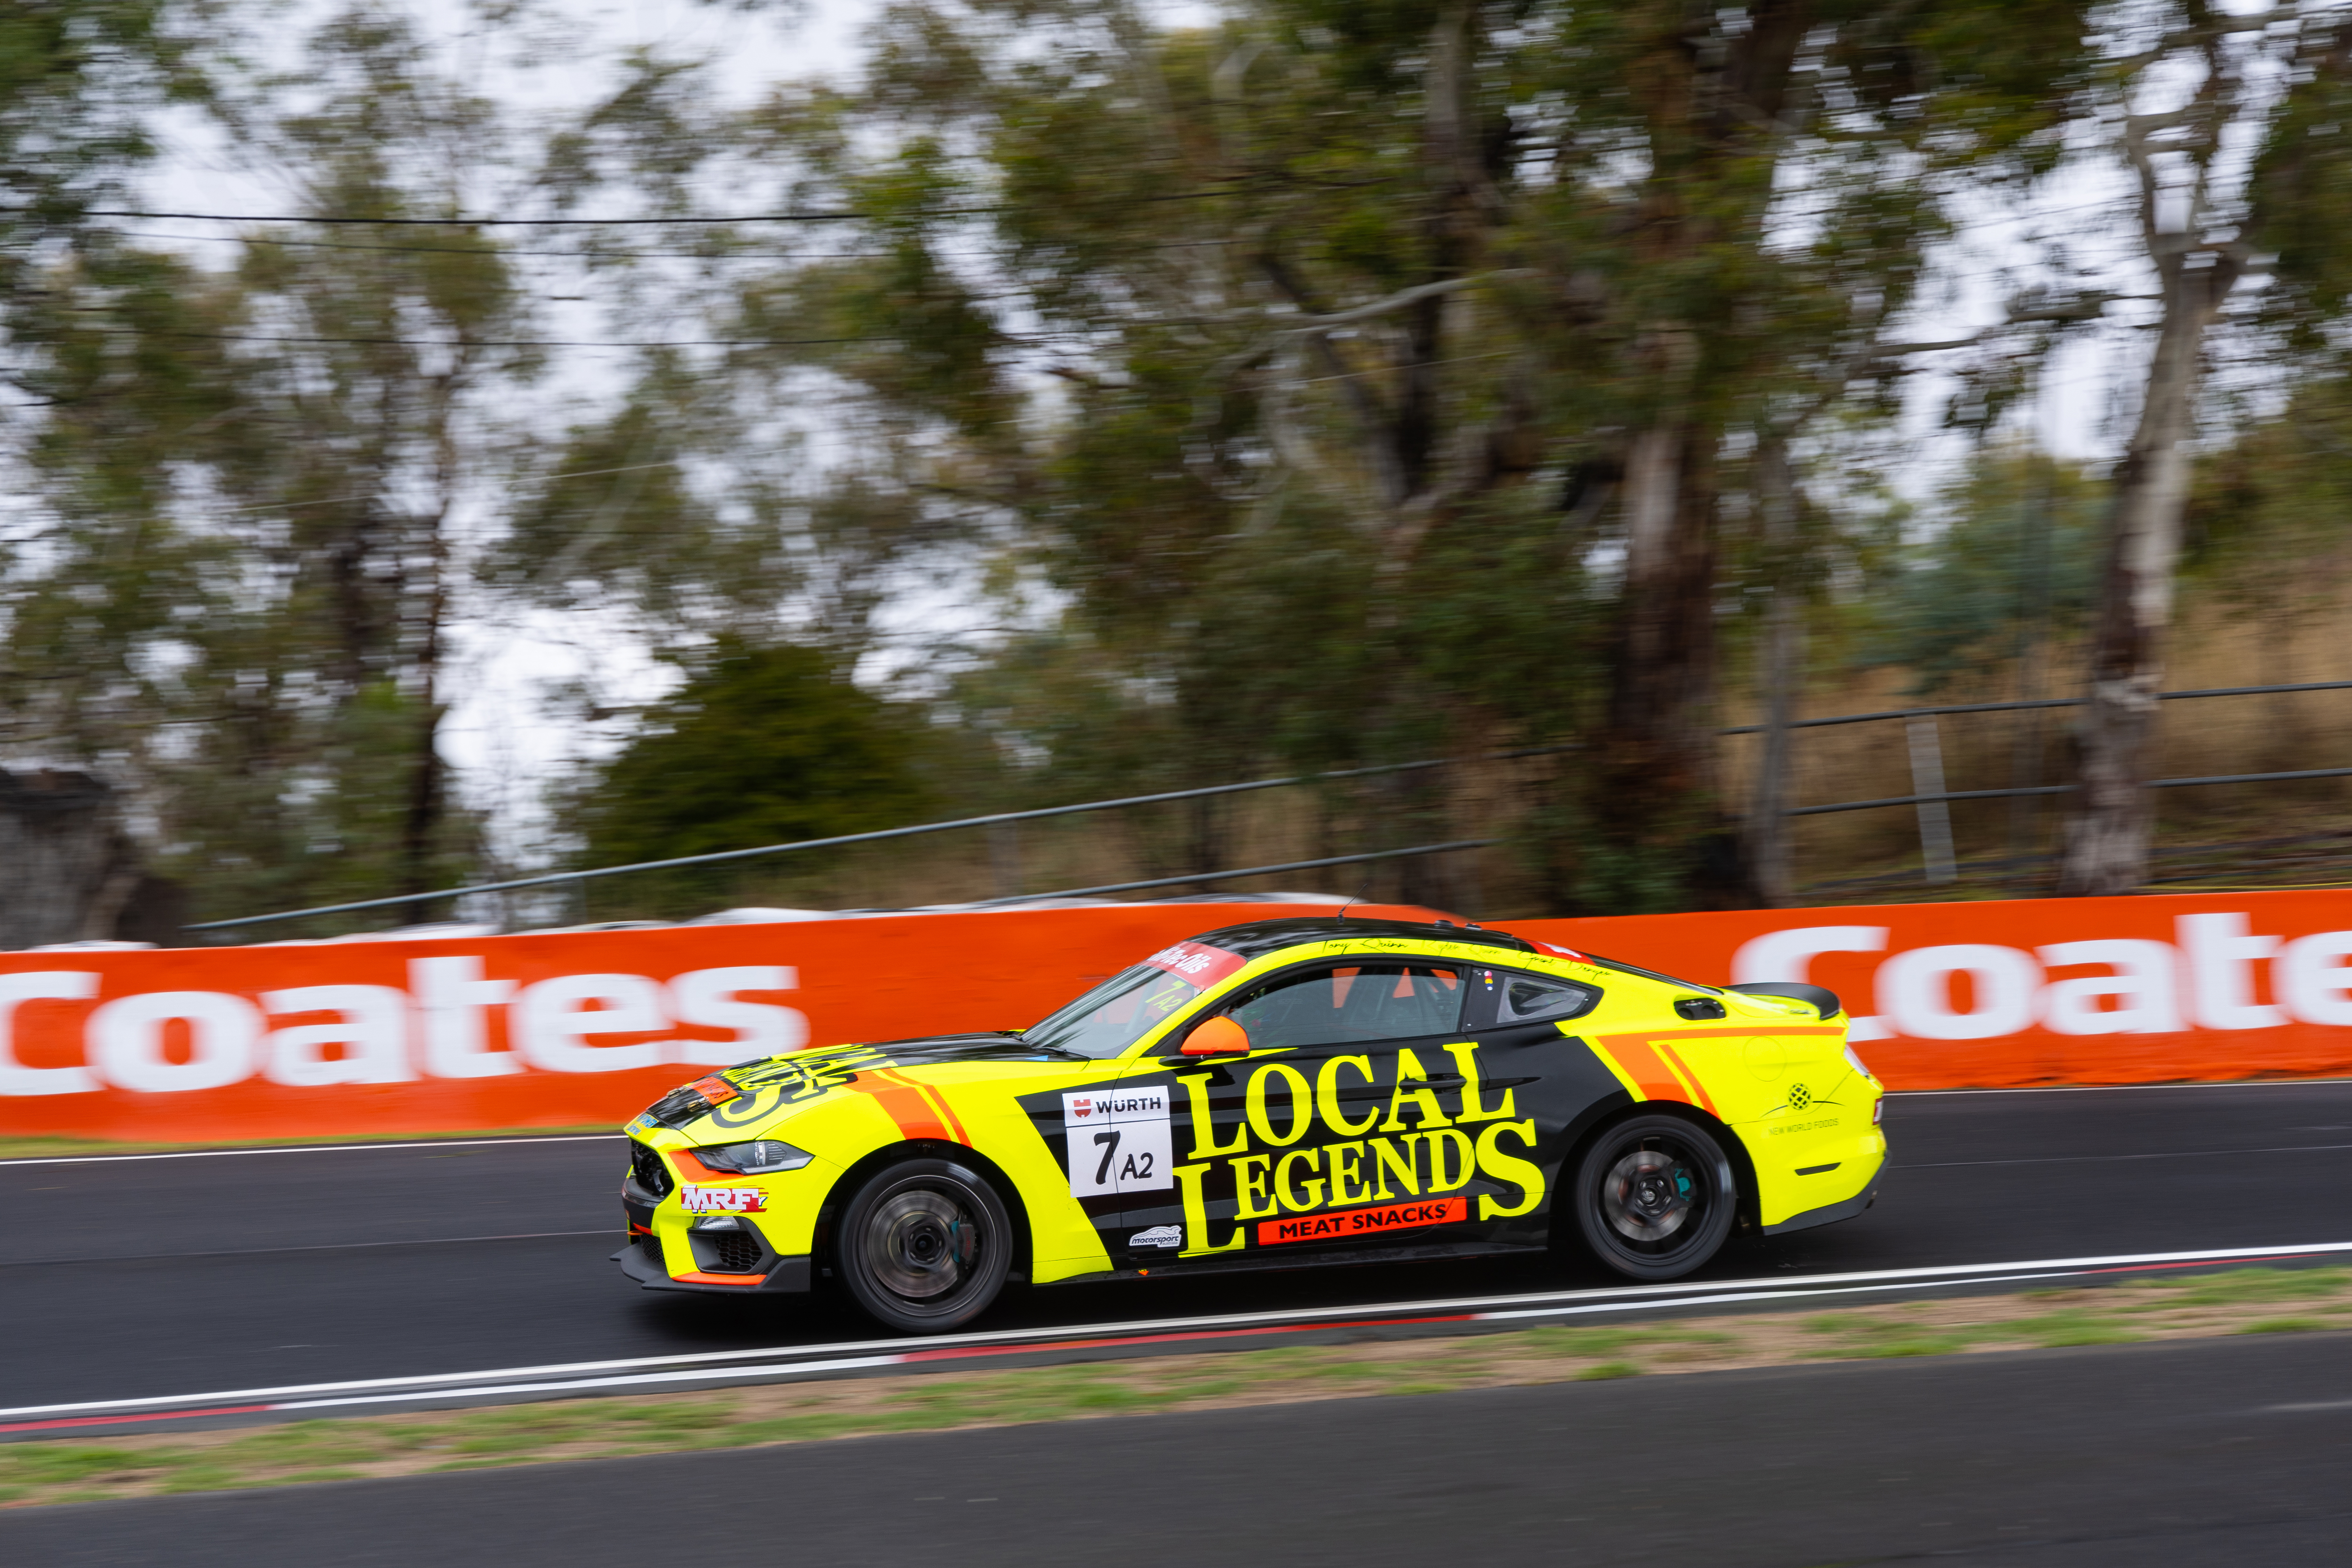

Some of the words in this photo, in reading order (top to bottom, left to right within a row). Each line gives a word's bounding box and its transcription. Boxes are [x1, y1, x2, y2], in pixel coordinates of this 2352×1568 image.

[1322, 940, 1351, 955] Tony
[1361, 939, 1408, 953] Quinn
[1174, 953, 1212, 974] Oils
[1145, 980, 1187, 1003] 7
[1153, 995, 1183, 1011] A2
[0, 955, 810, 1094] Coates
[1096, 1097, 1161, 1113] WÜRTH
[1176, 1042, 1516, 1160] LOCAL
[1814, 1118, 1839, 1129] FOODS
[1094, 1130, 1121, 1185] 7
[1120, 1152, 1153, 1180] A2
[682, 1188, 758, 1210] MRF
[1174, 1119, 1545, 1258] LEGENDS
[1279, 1222, 1342, 1239] MEAT
[1353, 1203, 1447, 1229] SNACKS
[1132, 1236, 1179, 1245] motorsport
